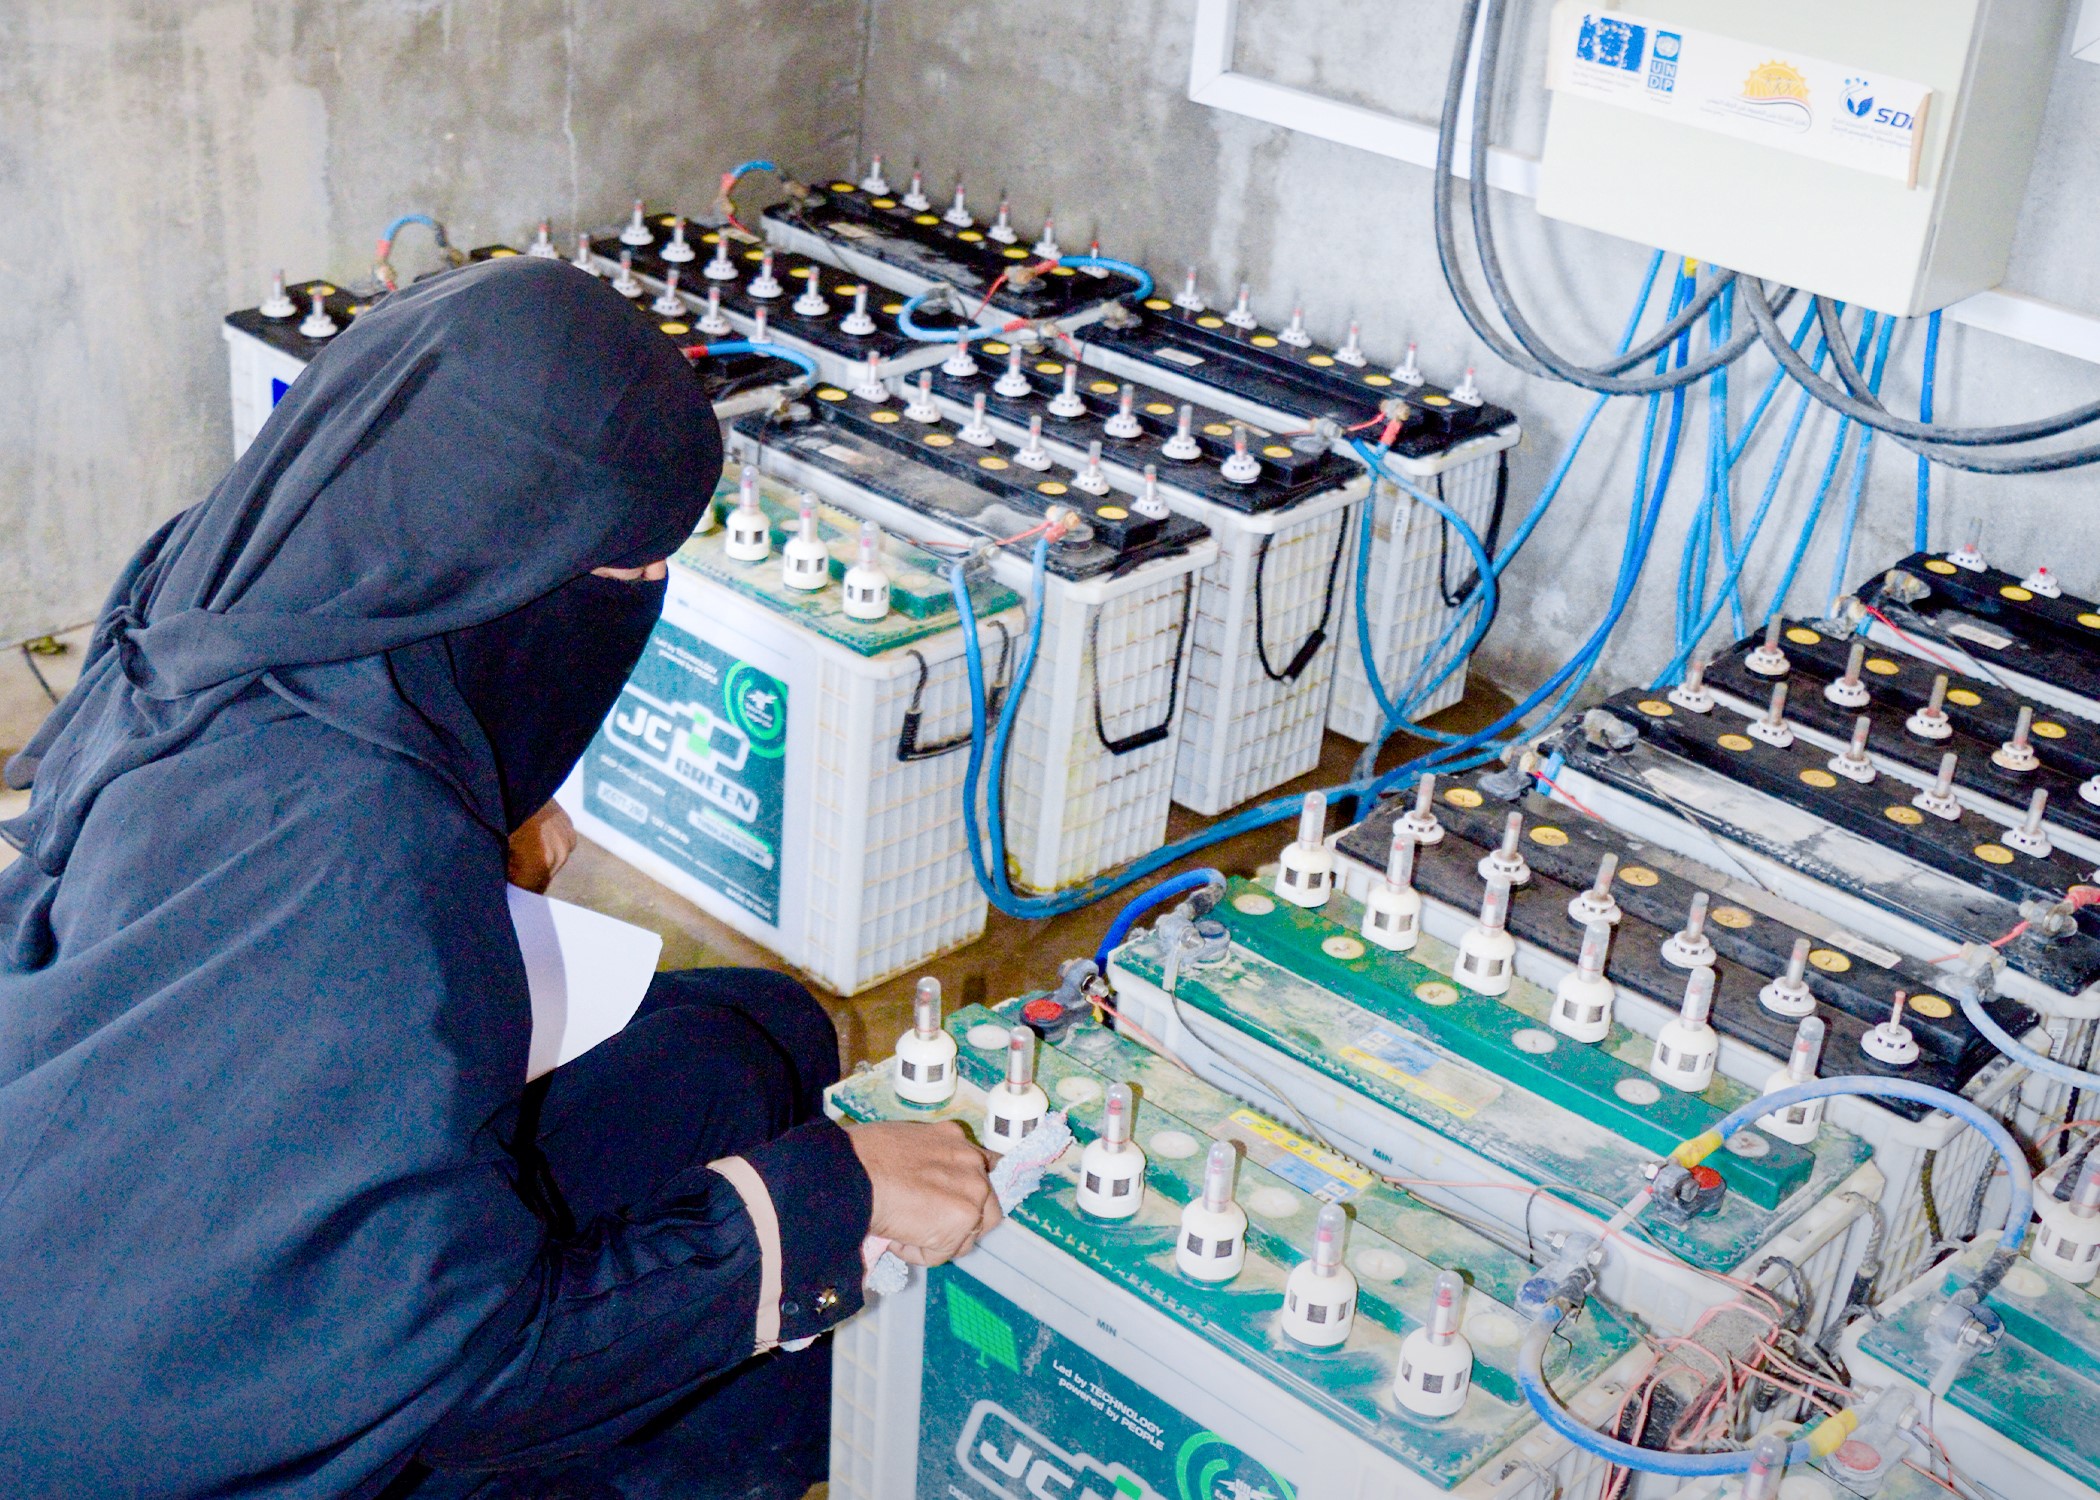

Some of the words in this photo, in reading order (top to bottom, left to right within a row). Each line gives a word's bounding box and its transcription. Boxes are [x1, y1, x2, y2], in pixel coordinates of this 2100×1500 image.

[617, 707, 671, 752] JC
[675, 757, 753, 813] GREEN
[1372, 1148, 1393, 1165] MIN
[1096, 1318, 1117, 1337] MIN
[1053, 1359, 1073, 1378] Led
[1074, 1373, 1087, 1389] by
[1090, 1382, 1164, 1437] TECHNOLOGY
[1058, 1377, 1105, 1411] powered
[1105, 1406, 1120, 1422] by
[1120, 1416, 1165, 1451] PEOPLE
[980, 1441, 1075, 1500] JC
